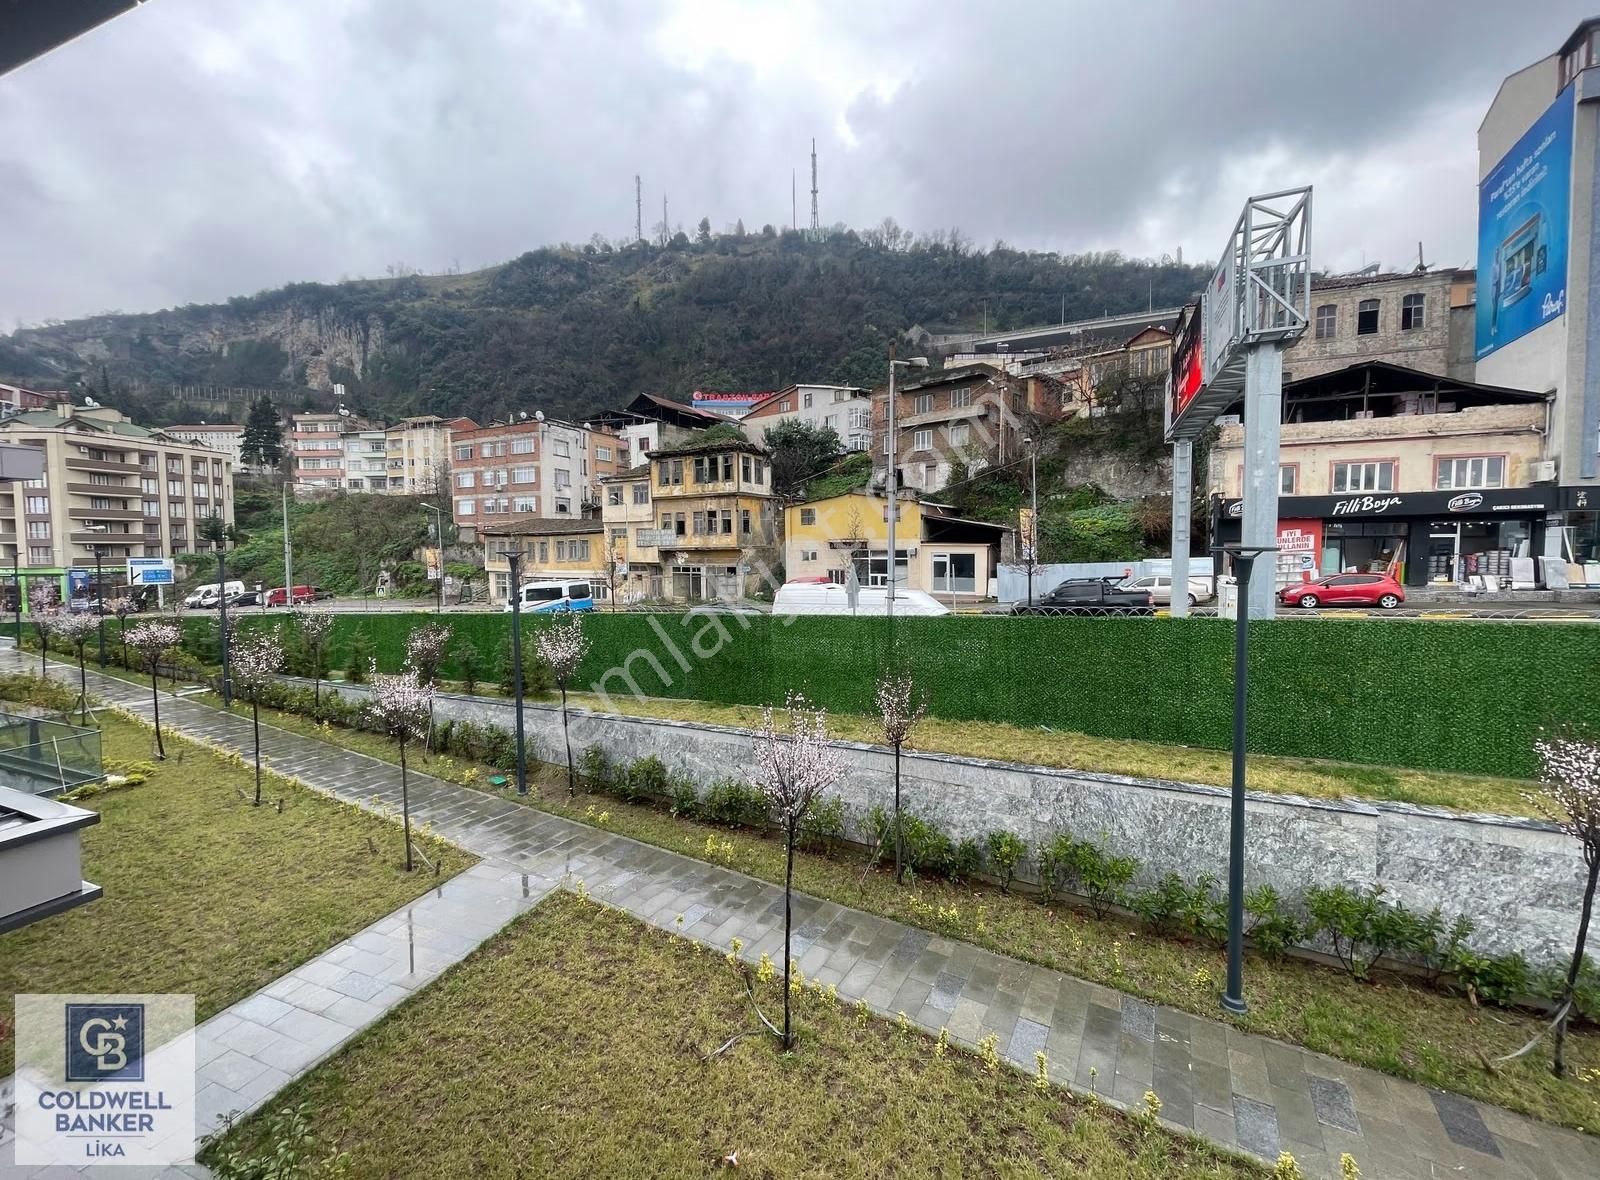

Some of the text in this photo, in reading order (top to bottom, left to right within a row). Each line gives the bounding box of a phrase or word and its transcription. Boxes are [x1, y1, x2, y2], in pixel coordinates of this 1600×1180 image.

[703, 393, 749, 401] TRABZON
[1332, 496, 1403, 516] Filli Boya
[1277, 542, 1310, 550] ULLANIN
